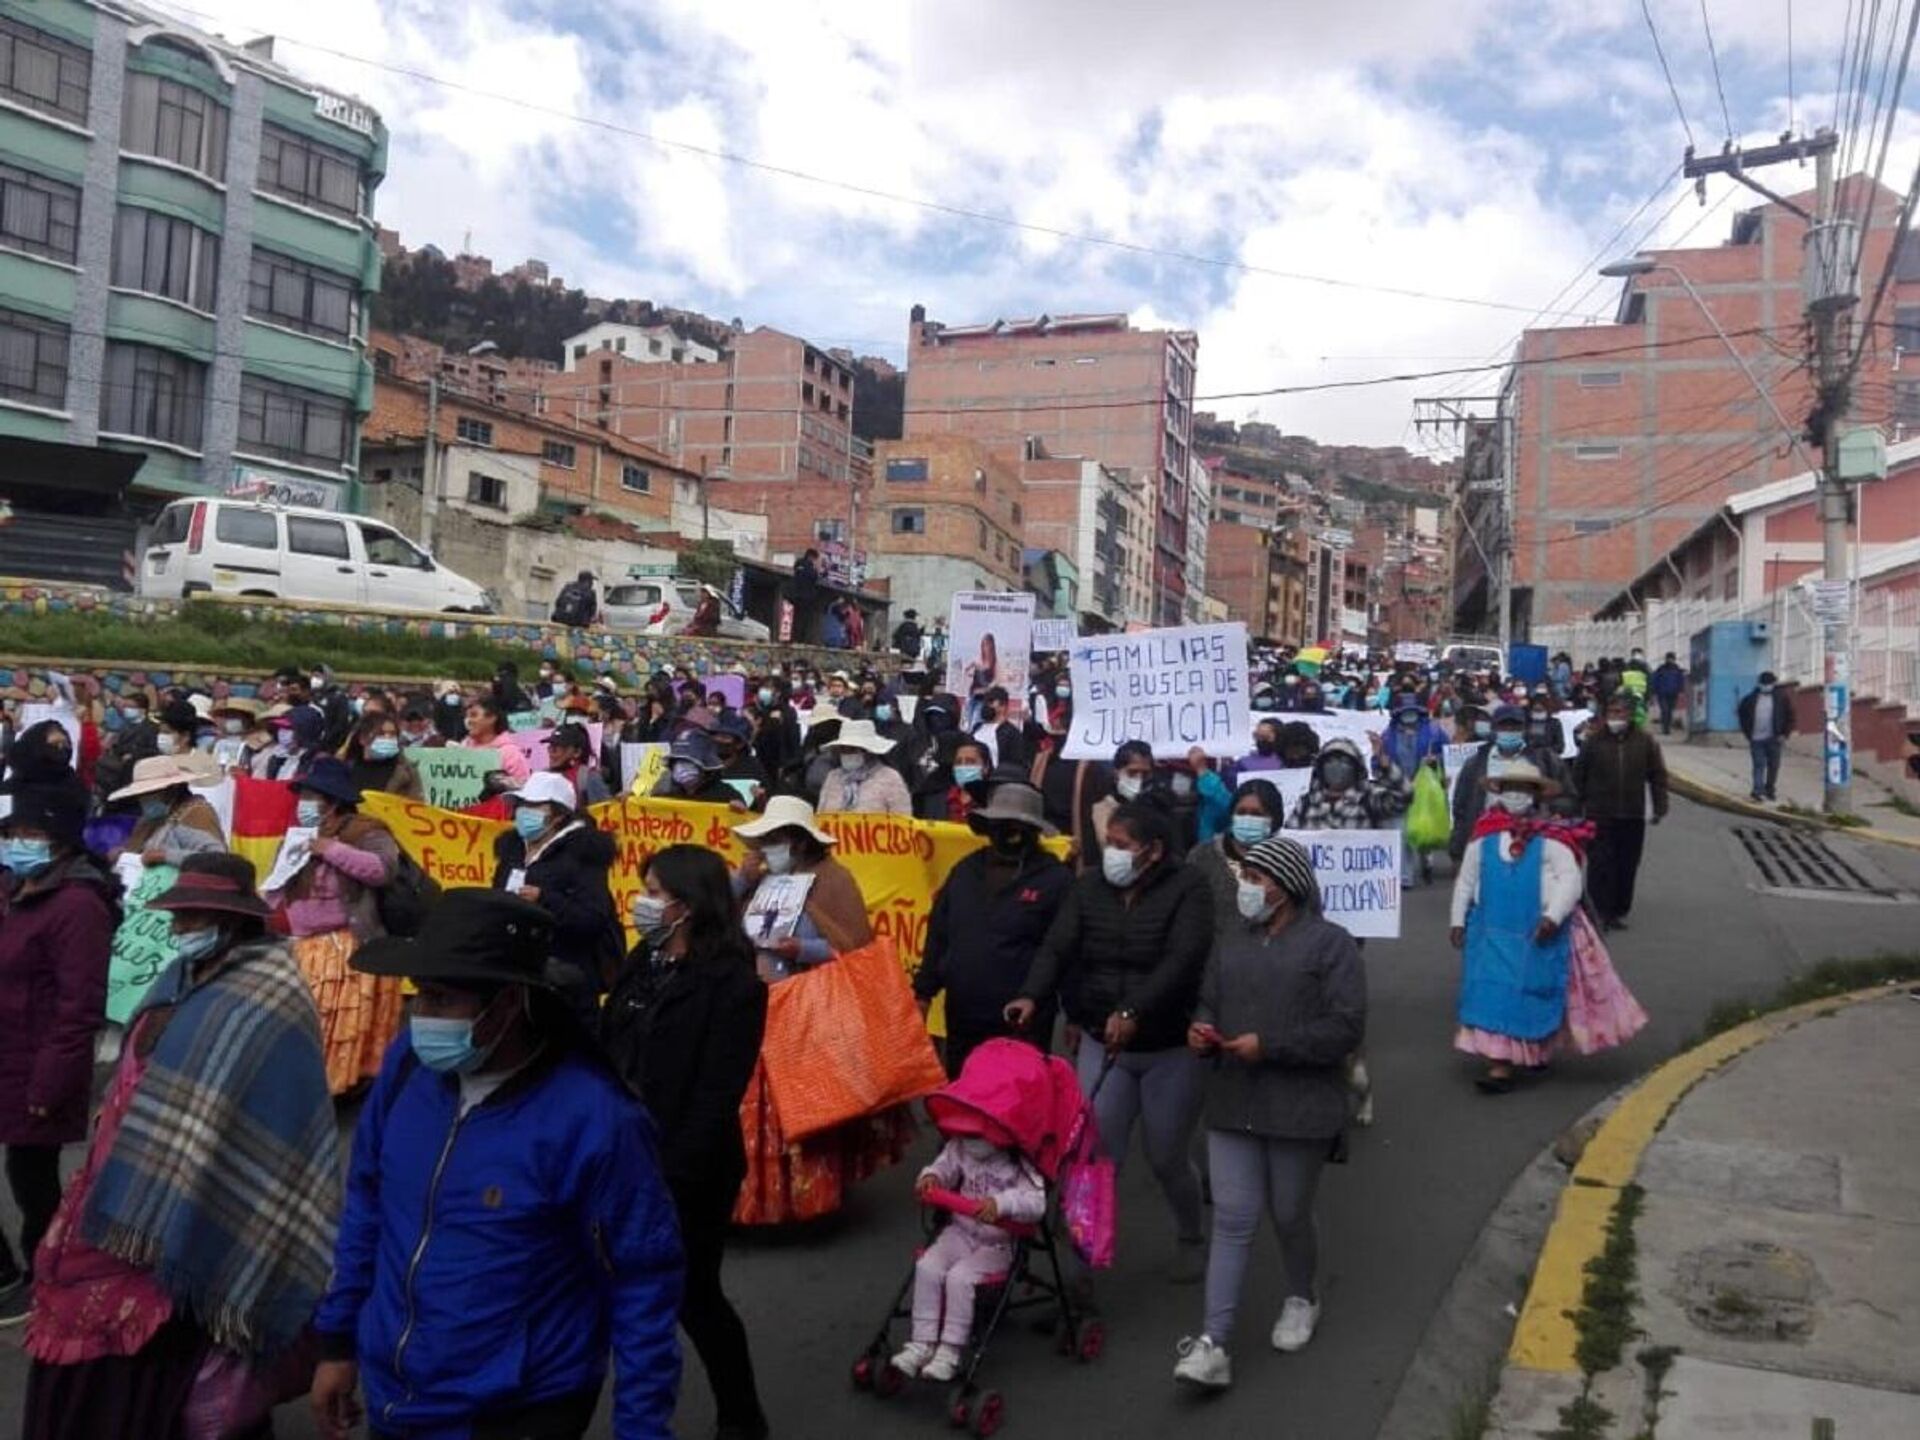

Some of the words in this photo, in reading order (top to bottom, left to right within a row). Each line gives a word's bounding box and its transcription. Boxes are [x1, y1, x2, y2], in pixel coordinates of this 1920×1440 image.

[1088, 635, 1225, 672] FAMILIAS
[1089, 680, 1117, 701] EN
[1128, 671, 1204, 697] BUSCA
[1214, 668, 1239, 694] DE
[1083, 701, 1231, 746] JUSTICIA
[405, 803, 482, 855] Soy
